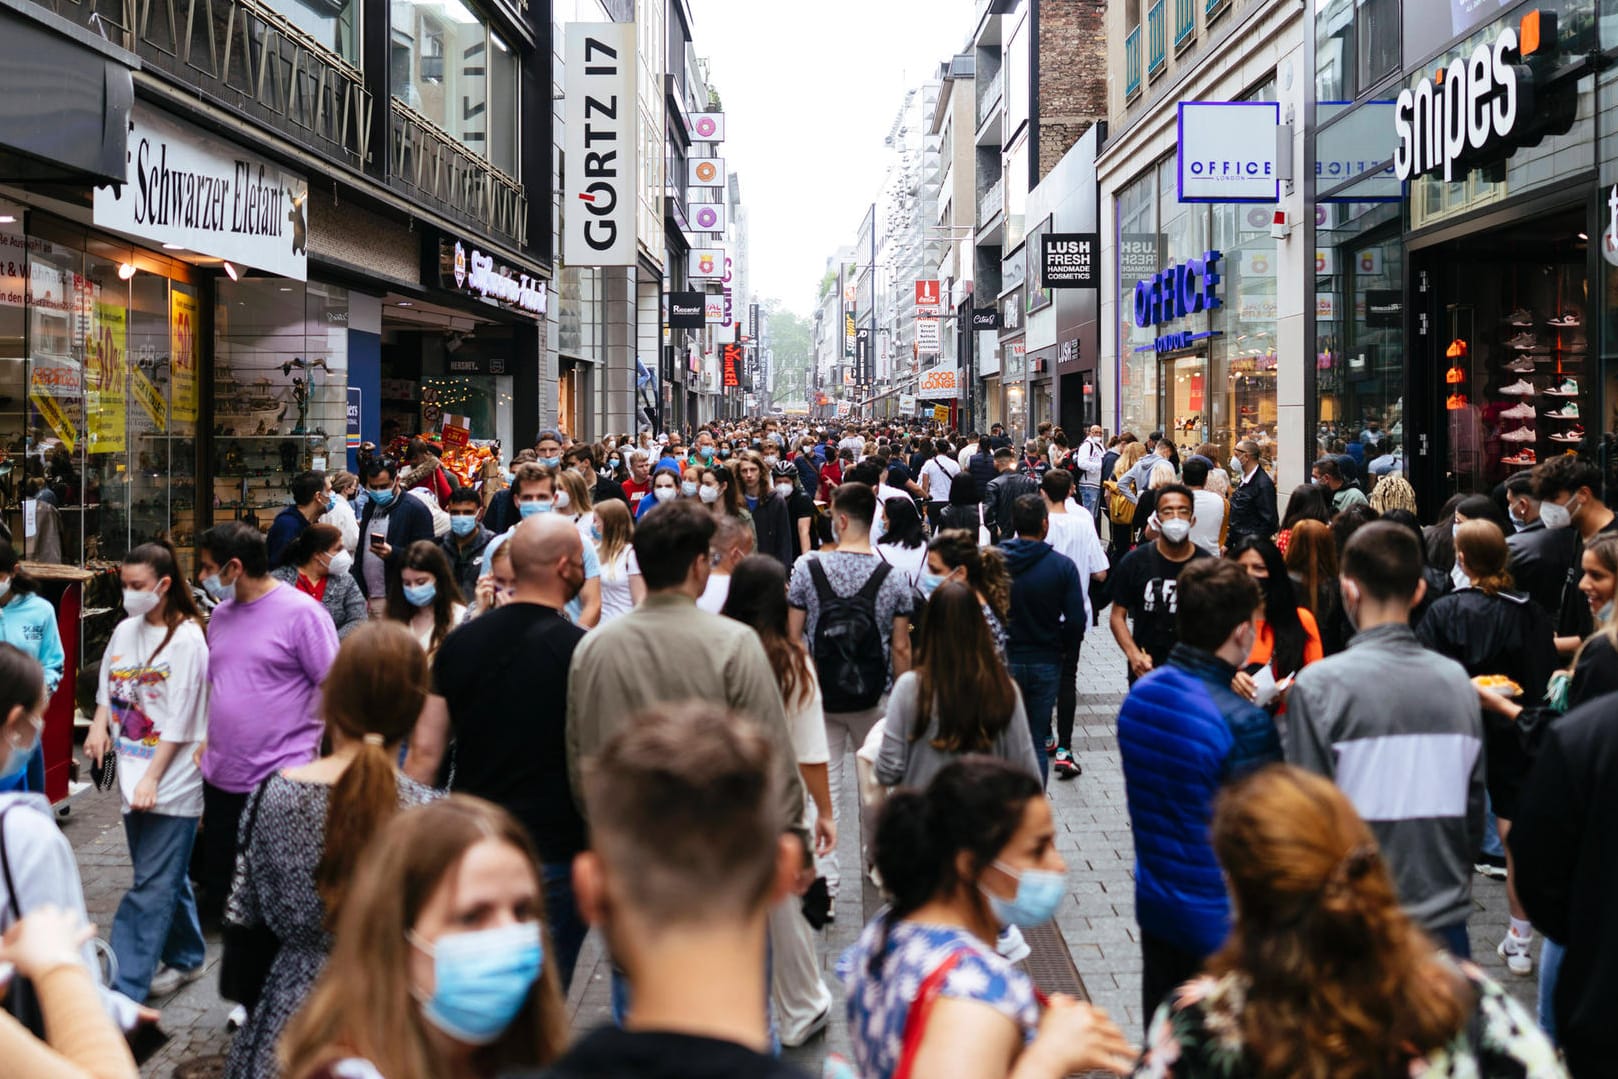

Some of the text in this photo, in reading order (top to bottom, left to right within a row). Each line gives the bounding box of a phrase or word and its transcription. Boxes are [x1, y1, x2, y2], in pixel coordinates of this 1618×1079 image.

[578, 95, 617, 251] GÖRTZ
[1190, 161, 1271, 175] OFFICE
[135, 138, 285, 237] Schwarzer Elefant
[1047, 241, 1090, 253] LUSH
[1047, 254, 1090, 265] FRESH
[1047, 272, 1090, 280] COSMETICS
[1135, 250, 1220, 329] OFFICE
[846, 313, 855, 354] SUBWAY
[724, 347, 742, 387] YORKER
[928, 371, 954, 381] FOOD
[921, 380, 956, 389] LOUNGE
